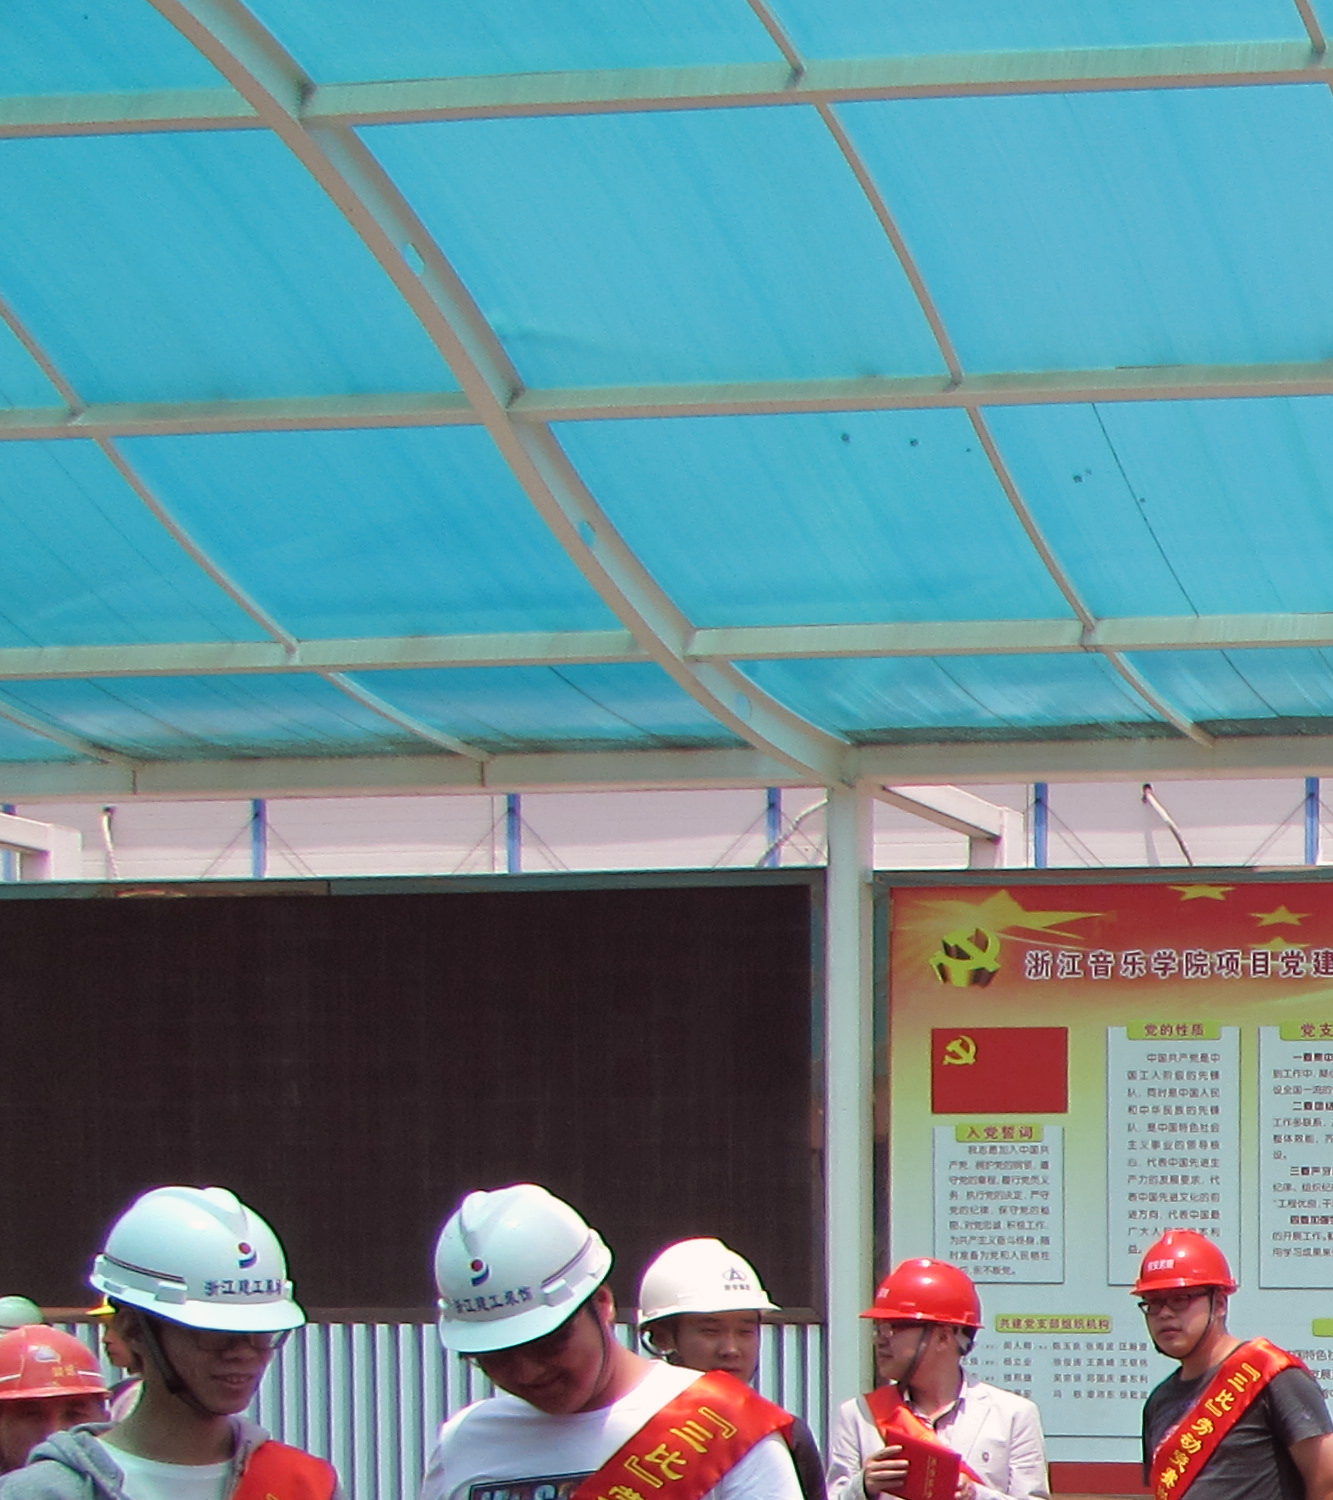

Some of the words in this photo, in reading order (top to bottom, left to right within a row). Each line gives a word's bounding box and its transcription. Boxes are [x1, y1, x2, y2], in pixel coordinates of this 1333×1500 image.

[1145, 1023, 1205, 1037] 党的性质
[967, 1126, 1033, 1139] 入党誓词
